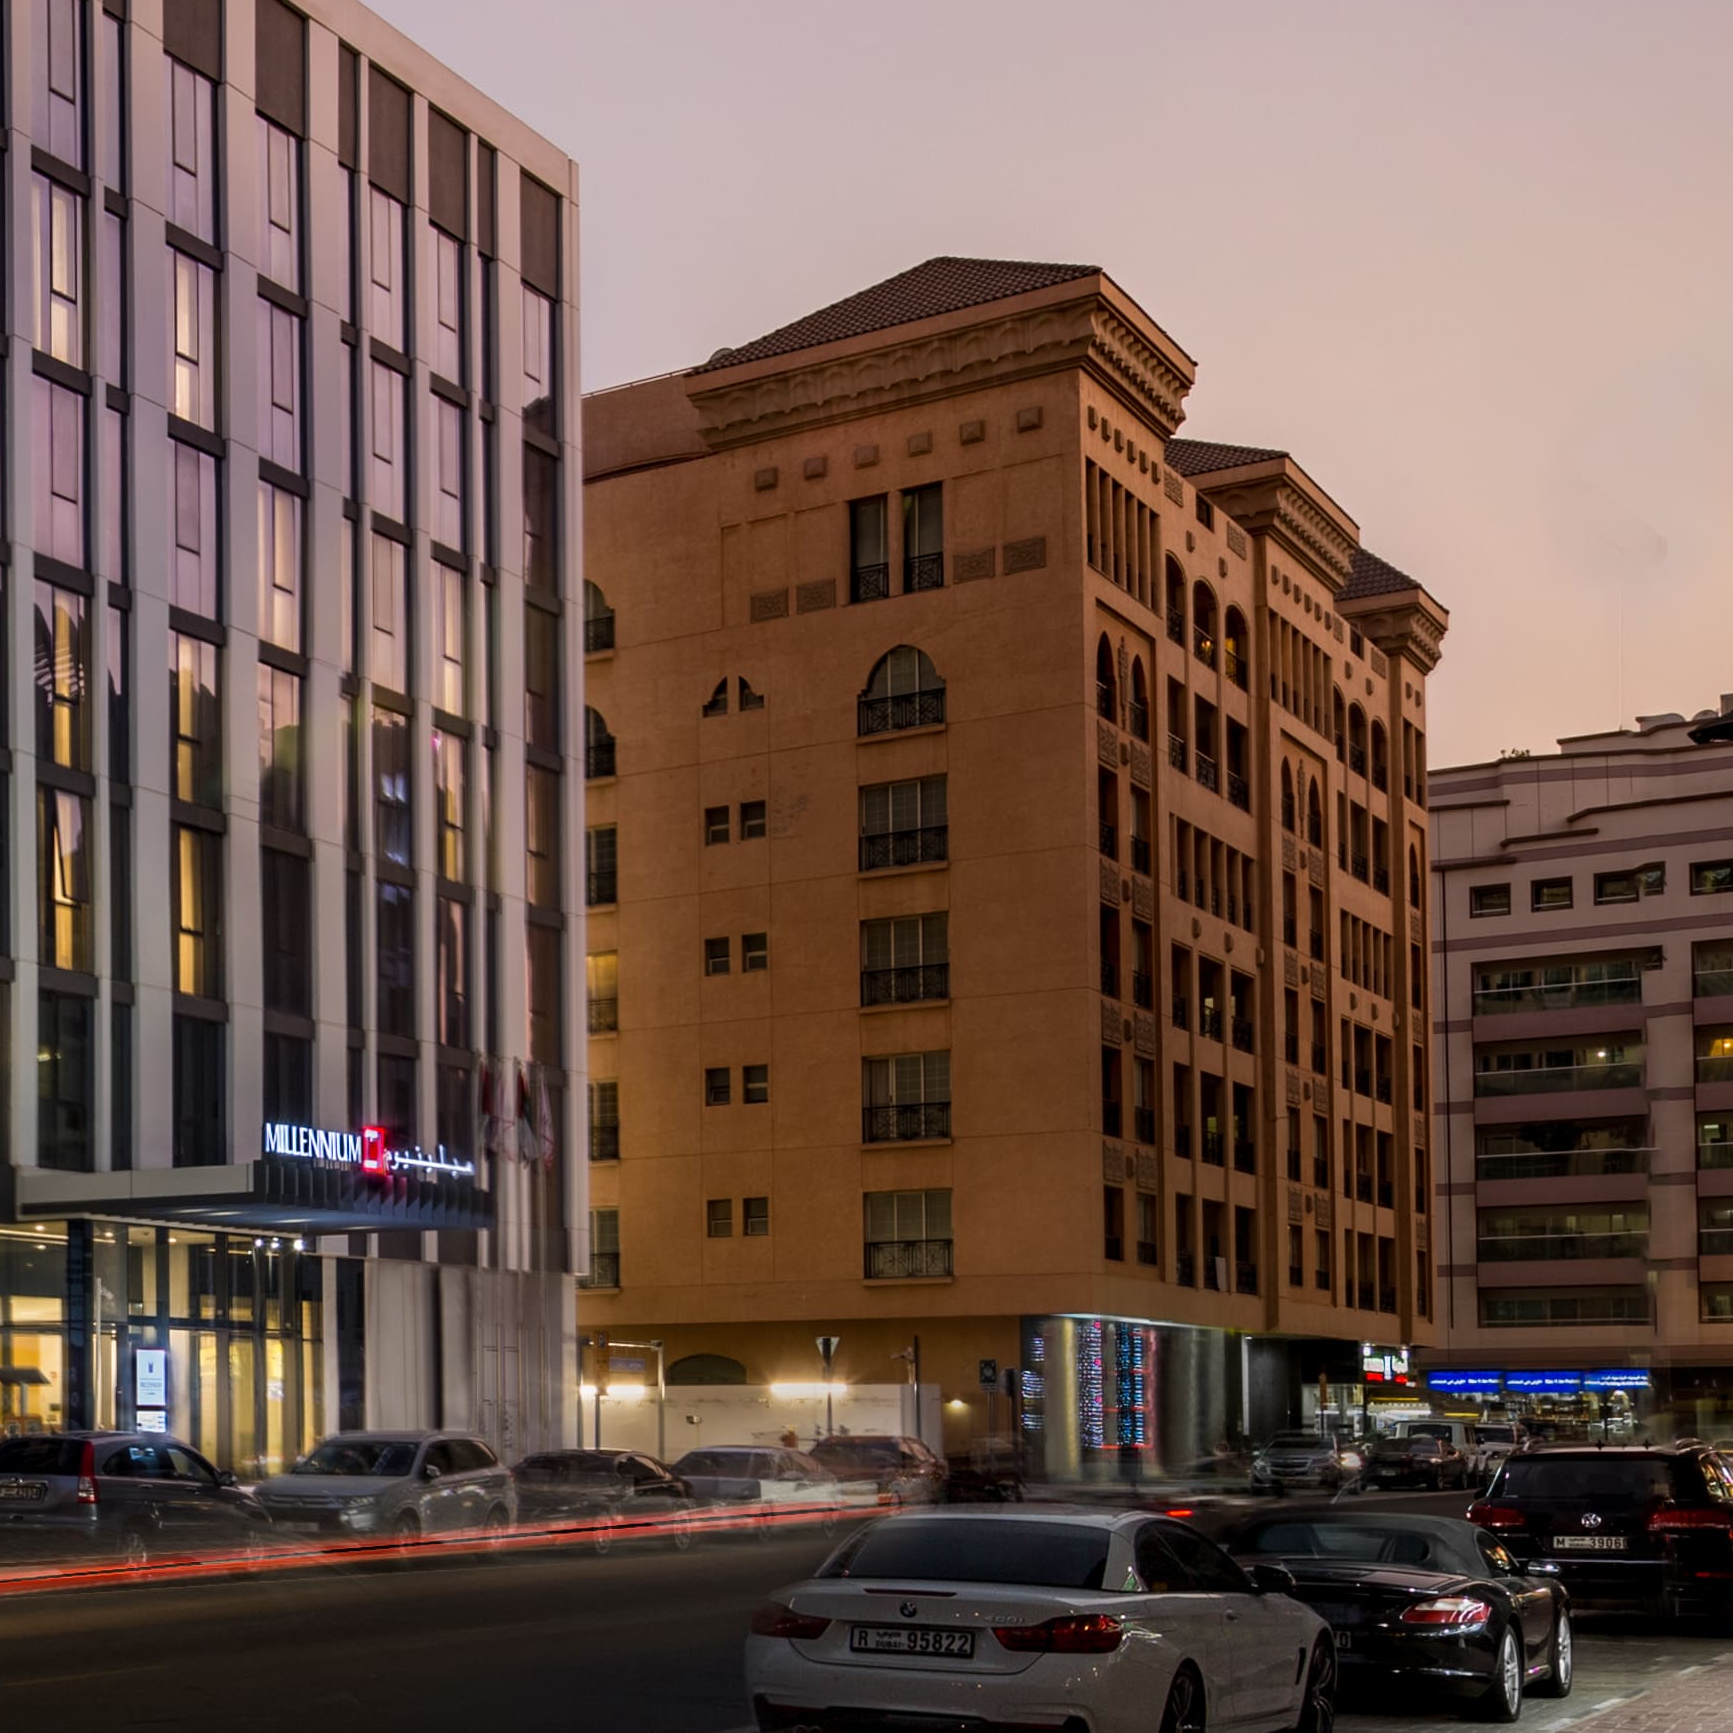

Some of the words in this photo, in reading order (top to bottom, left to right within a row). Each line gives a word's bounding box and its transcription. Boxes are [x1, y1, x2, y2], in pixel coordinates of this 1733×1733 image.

[264, 1122, 362, 1164] MILLENNIUM
[1556, 1537, 1566, 1547] M
[858, 1630, 868, 1647] R
[907, 1632, 969, 1653] 95822
